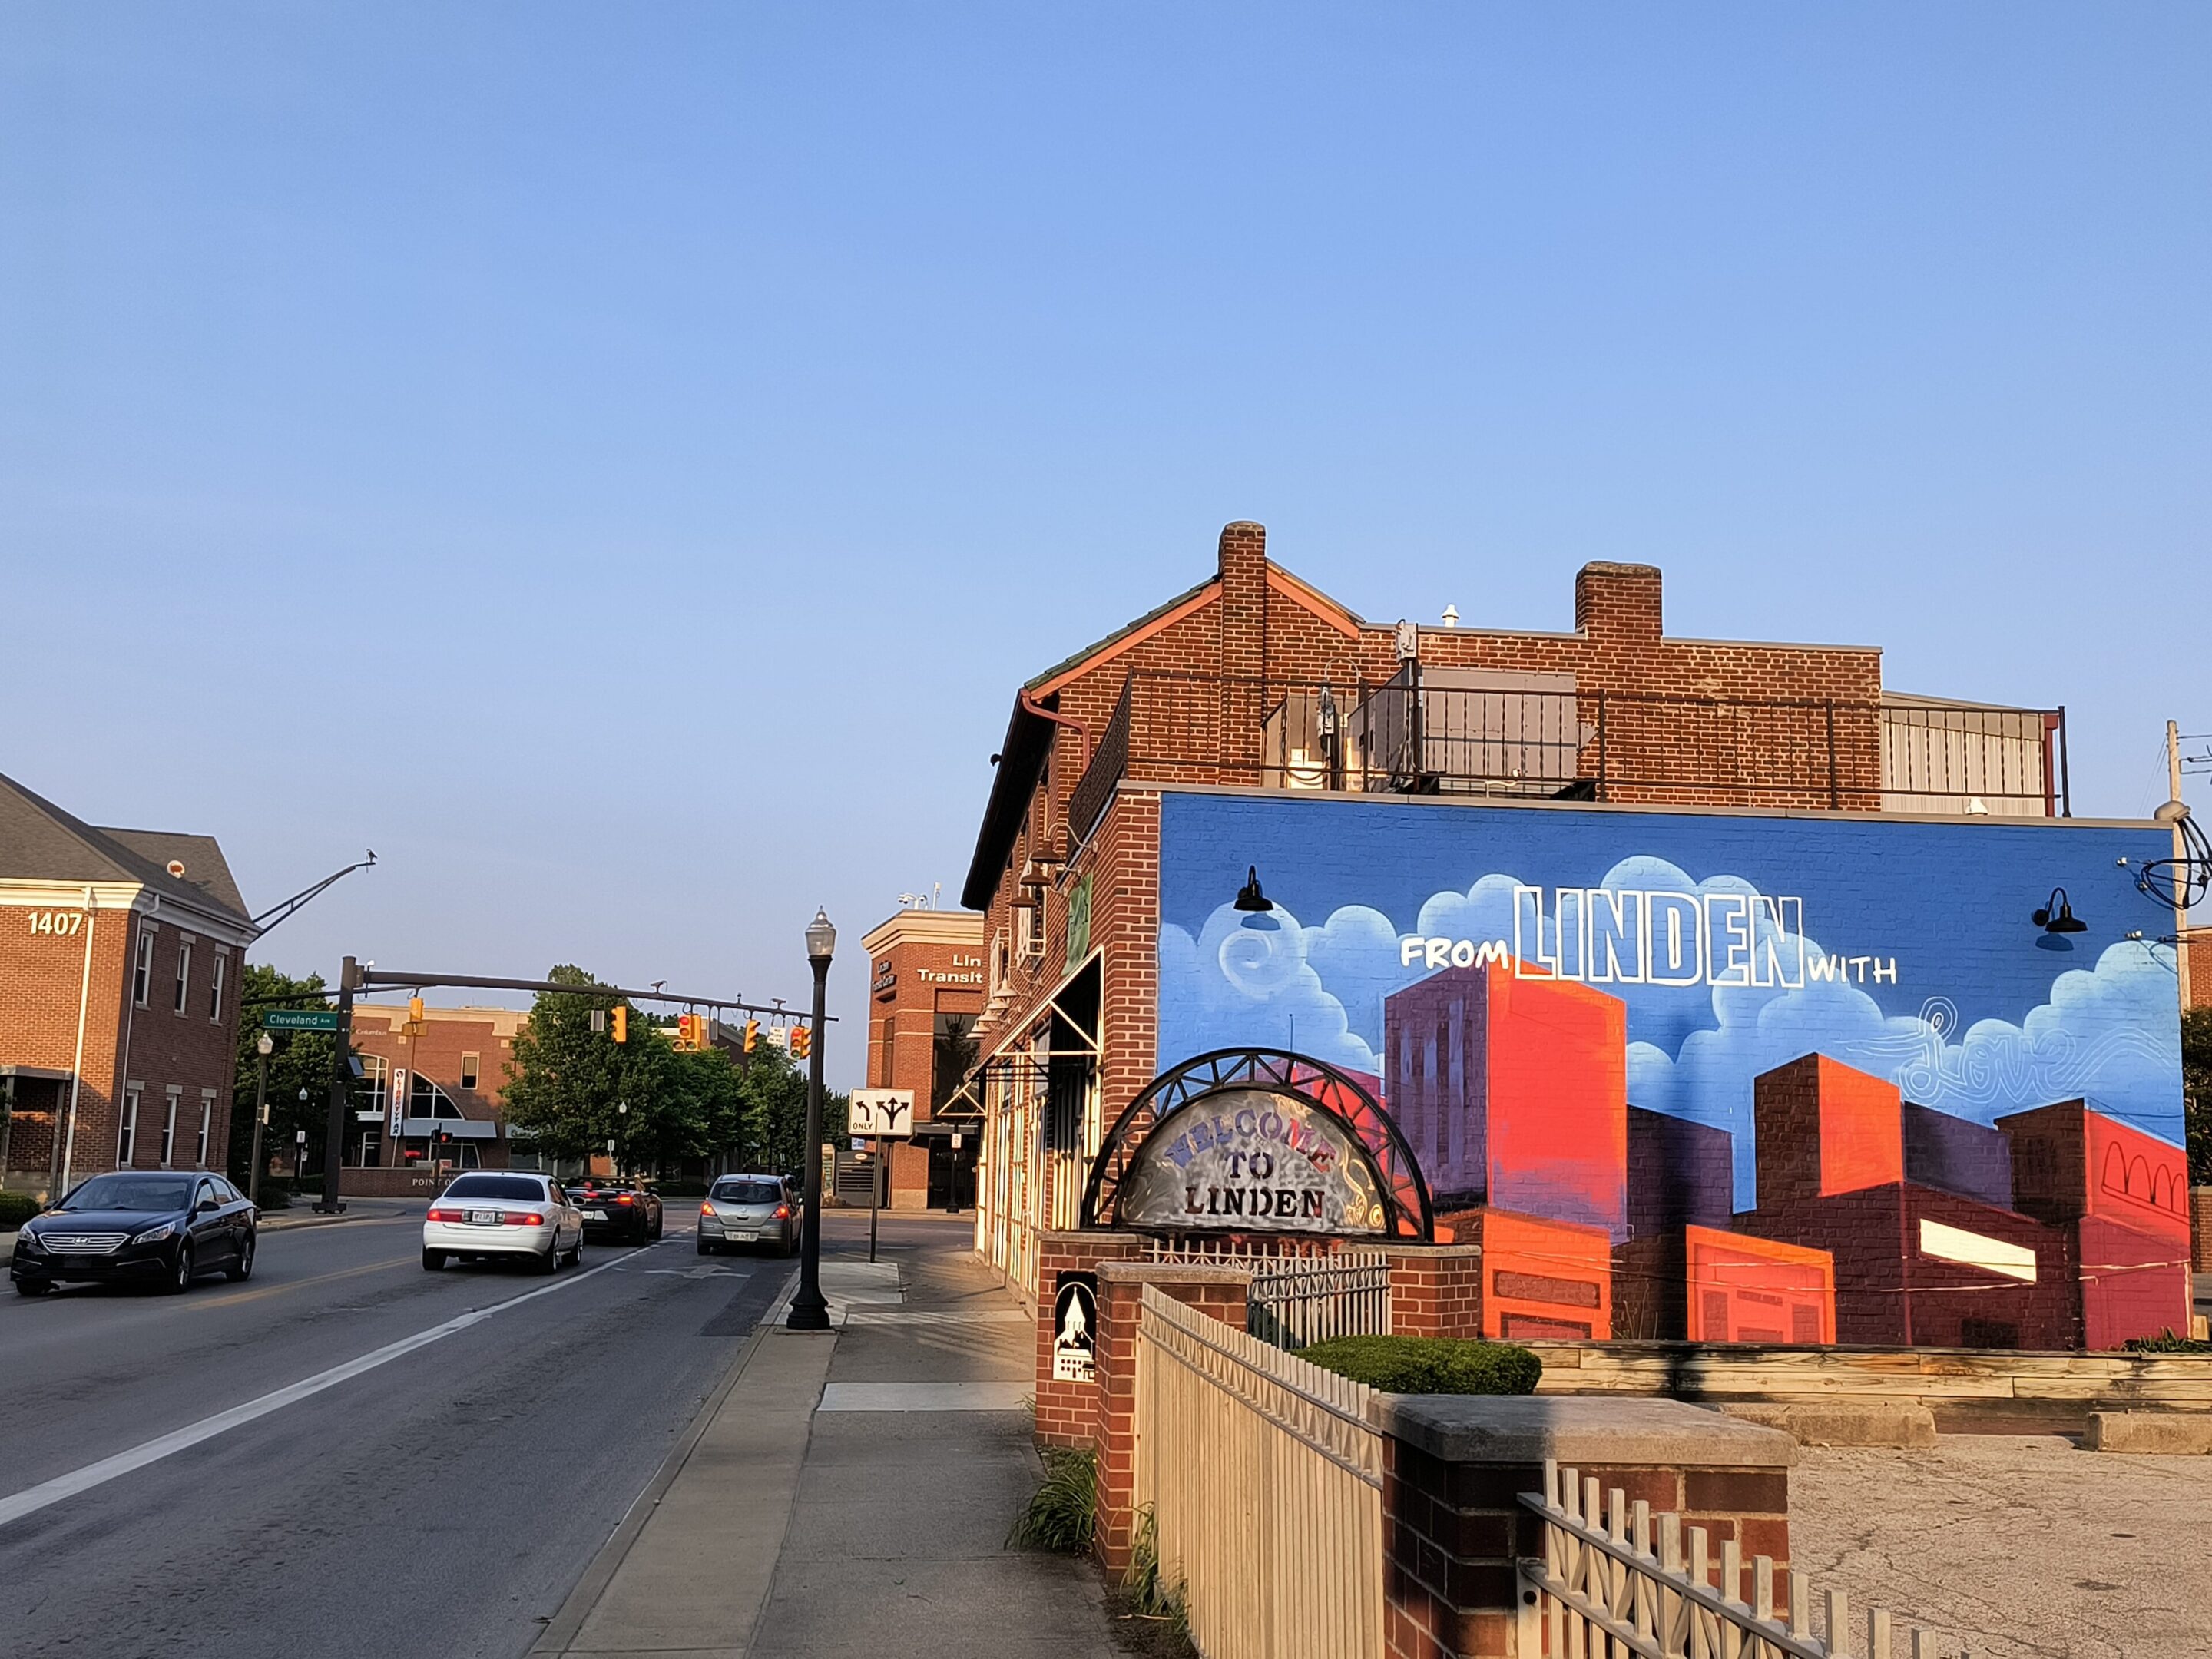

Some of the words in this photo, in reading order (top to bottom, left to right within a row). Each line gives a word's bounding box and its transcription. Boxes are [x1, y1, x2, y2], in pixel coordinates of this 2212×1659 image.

[28, 912, 84, 935] 1407
[1400, 936, 1509, 970] FROM
[1513, 886, 1805, 988] LINDEN
[1806, 953, 1897, 985] WITH
[916, 969, 983, 983] Transit
[269, 1014, 319, 1025] Cleveland
[1164, 1108, 1337, 1174] WELCOME
[1225, 1151, 1274, 1180] TO
[1184, 1187, 1326, 1218] LINDEN
